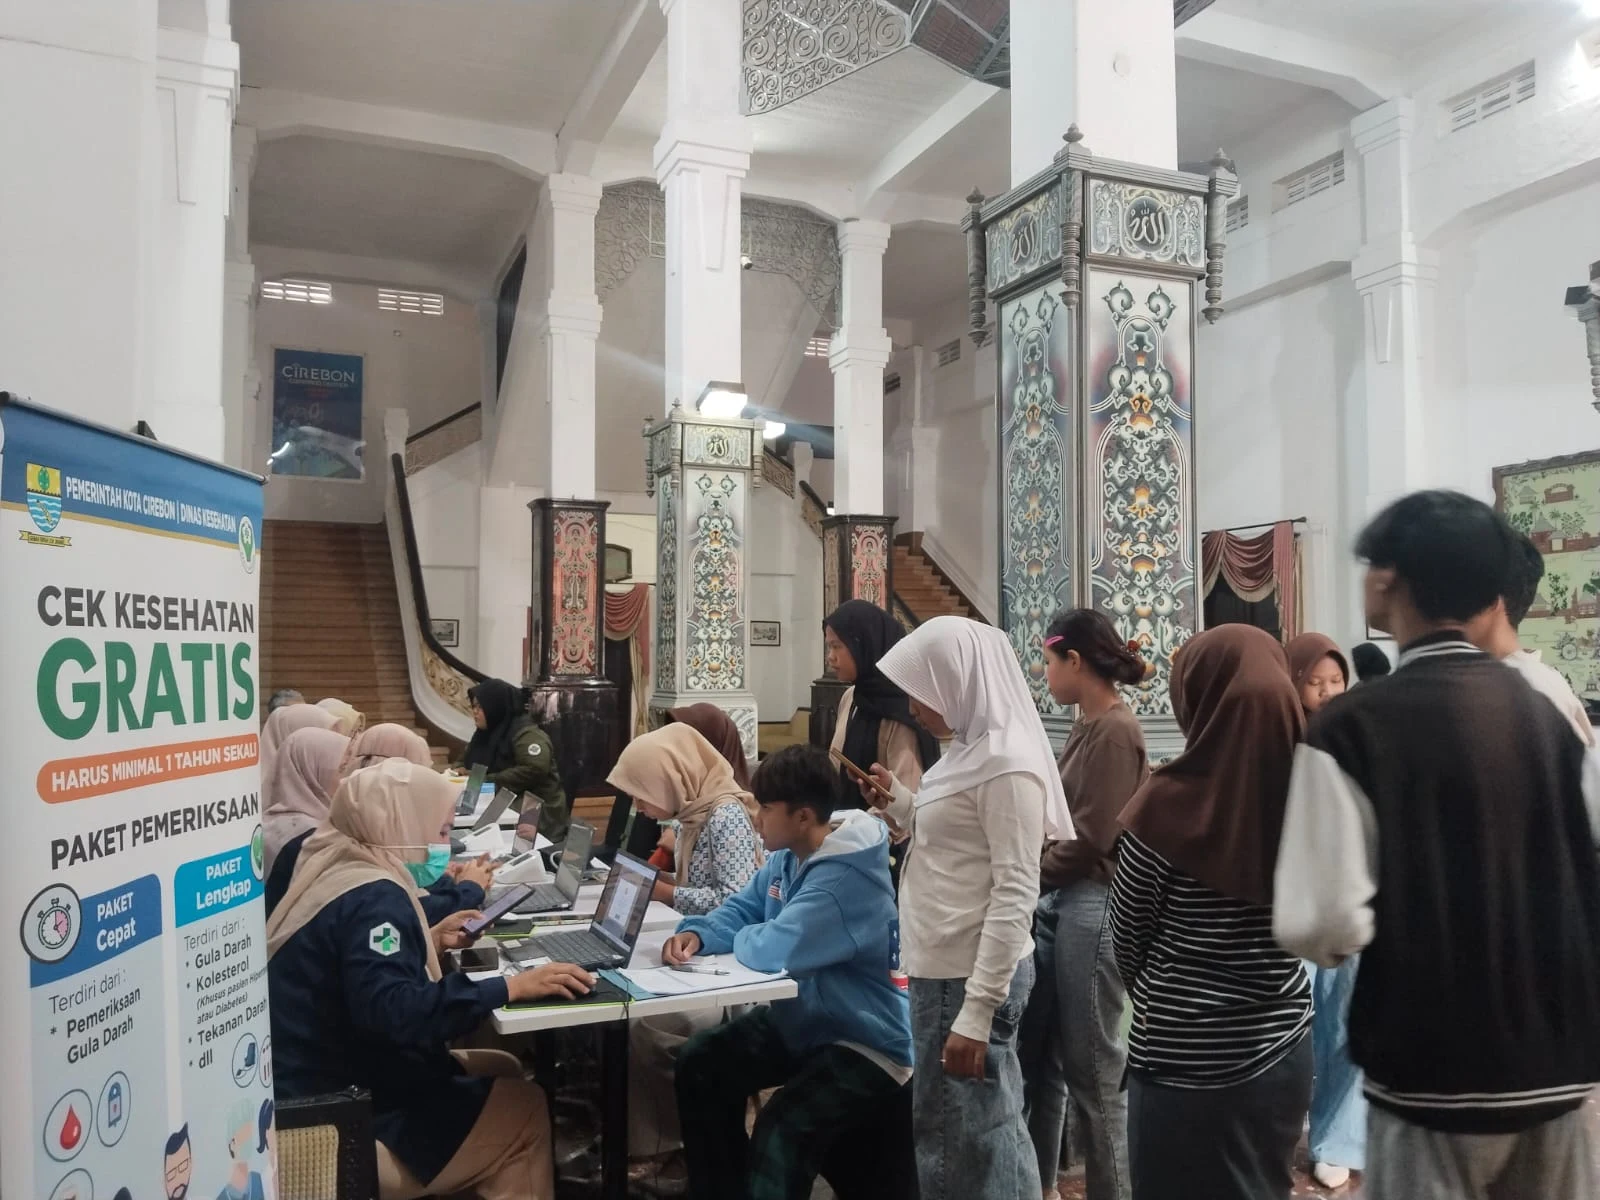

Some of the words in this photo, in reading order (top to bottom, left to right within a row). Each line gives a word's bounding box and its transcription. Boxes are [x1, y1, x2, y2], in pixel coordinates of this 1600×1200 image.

[281, 364, 355, 383] CIREBON
[66, 476, 122, 509] PEMERINTAH
[122, 489, 142, 513] KOTA
[142, 494, 176, 520] CIREBON
[180, 503, 202, 525] DINAS
[202, 508, 237, 533] KESEHATAN
[37, 585, 107, 627] CEK
[115, 591, 254, 633] KESEHATAN
[37, 637, 255, 740] GRATIS
[52, 764, 109, 792] HARUS
[112, 758, 163, 782] MINIMAL
[165, 755, 172, 771] 1
[174, 749, 221, 769] TAHUN
[223, 742, 257, 762] SEKALI
[51, 823, 126, 870] PAKET
[132, 791, 259, 847] PEMERIKSAAN
[206, 856, 242, 881] PAKET
[97, 892, 134, 922] PAKET
[195, 878, 252, 910] Lengkap
[96, 917, 136, 951] Cepat
[184, 925, 218, 951] Terdiri
[221, 920, 240, 937] dari
[195, 948, 221, 969] Gula
[224, 933, 252, 958] Darah
[48, 980, 96, 1014] Terdiri
[100, 967, 121, 994] dari
[196, 955, 250, 992] Kolesterol
[196, 987, 226, 1010] (Khusus
[227, 976, 249, 995] pasien
[196, 1010, 214, 1025] atau
[215, 991, 248, 1016] Diabetes)
[66, 987, 141, 1038] Pemeriksaan
[198, 1014, 243, 1046] Tekanan
[245, 998, 267, 1022] Darah
[67, 1036, 100, 1064] Gula
[103, 1014, 133, 1046] Darah
[198, 1048, 213, 1069] dll
